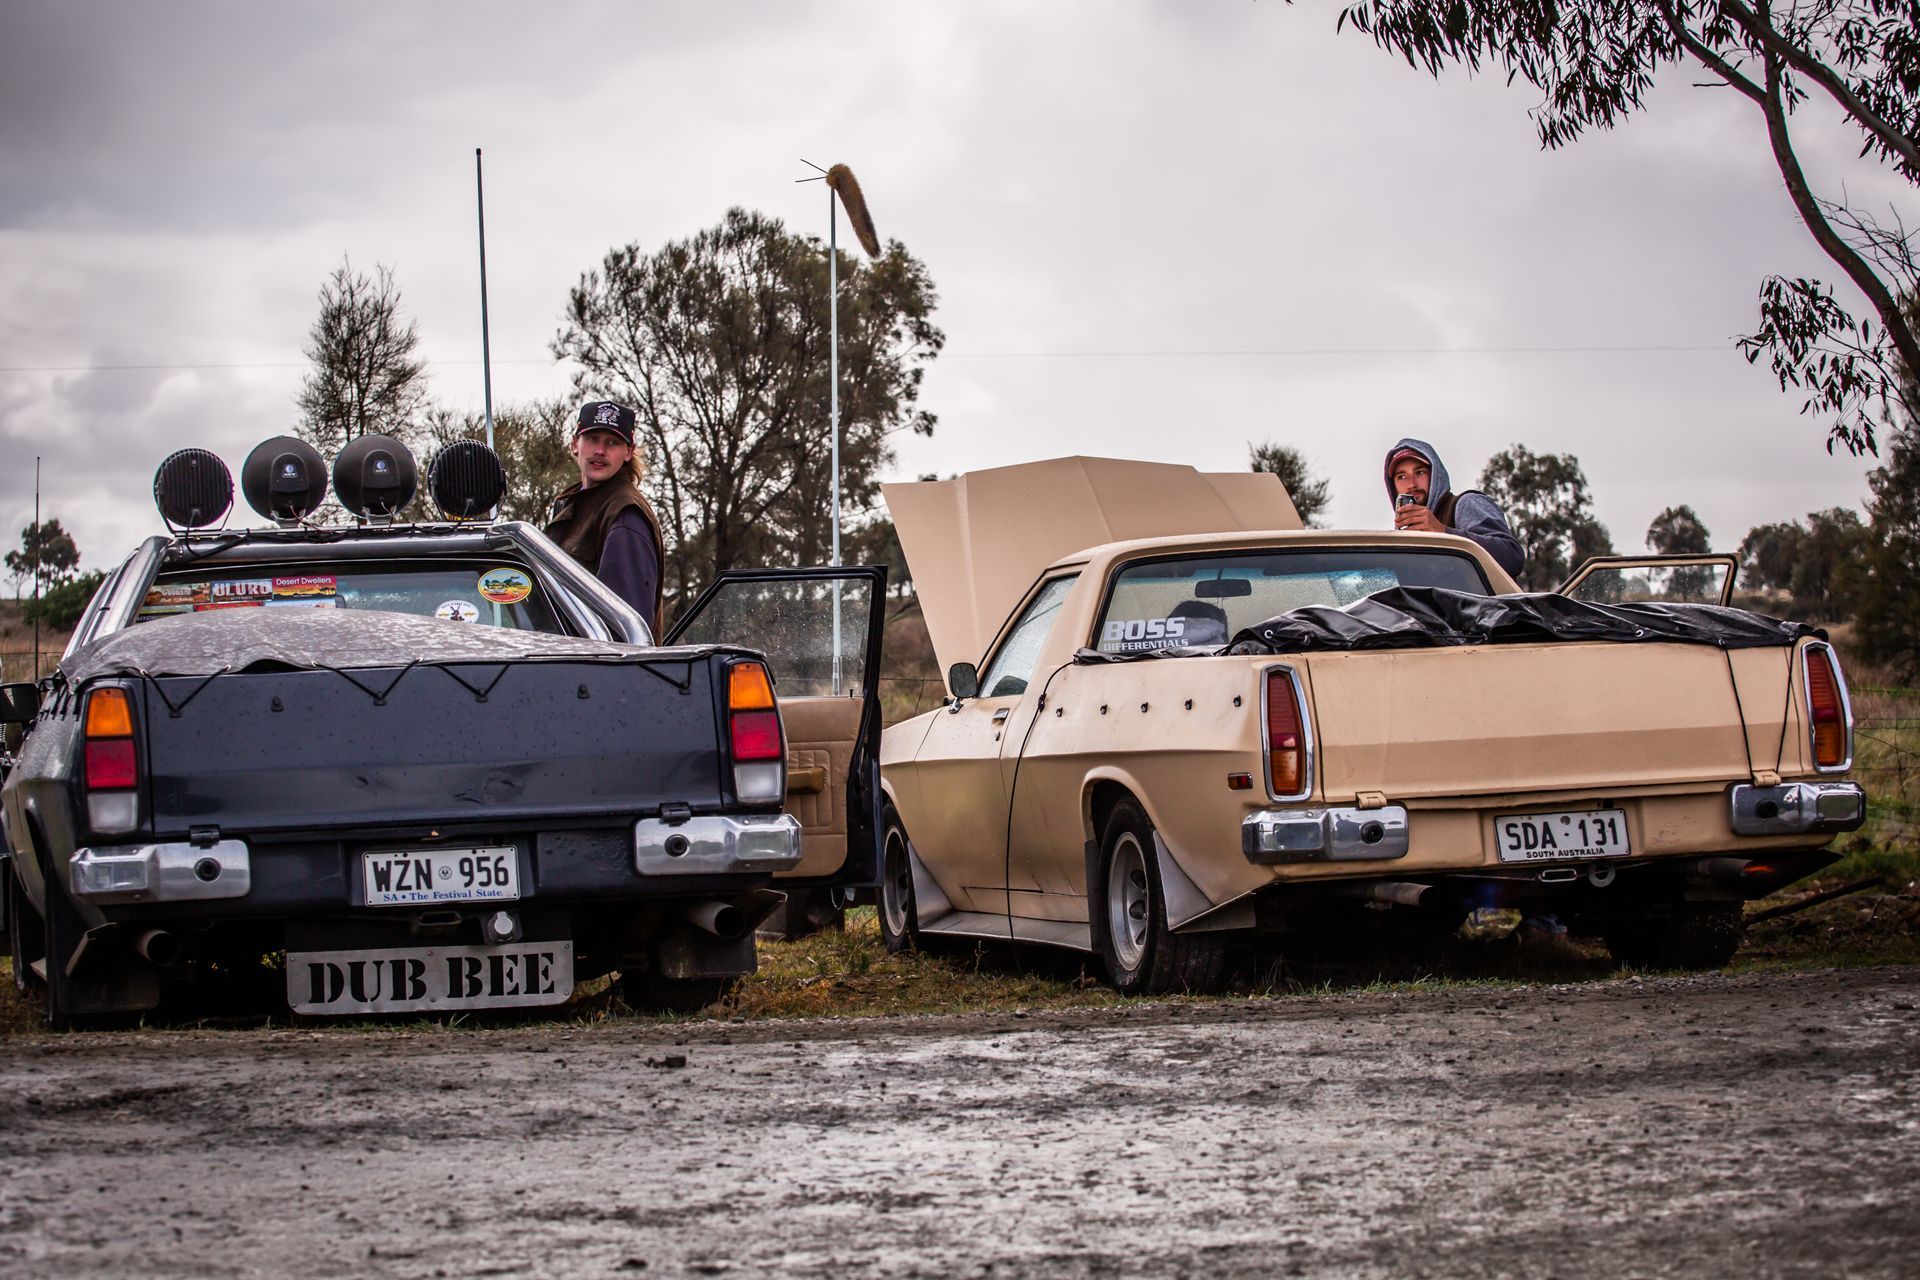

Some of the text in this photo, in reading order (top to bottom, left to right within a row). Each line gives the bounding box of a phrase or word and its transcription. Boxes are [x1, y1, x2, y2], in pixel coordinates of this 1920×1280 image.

[214, 581, 271, 597] ULURU
[276, 577, 332, 586] Desert Dwellers
[1103, 616, 1186, 641] BOSS
[1103, 638, 1189, 651] DIFFERENTIALS
[1505, 817, 1619, 850] SDA 131
[1526, 848, 1605, 859] SOUTH AUSTRALIA
[372, 855, 510, 892] WZN 956
[383, 889, 503, 902] SA The Festival State
[308, 952, 555, 1004] DUB BEE
